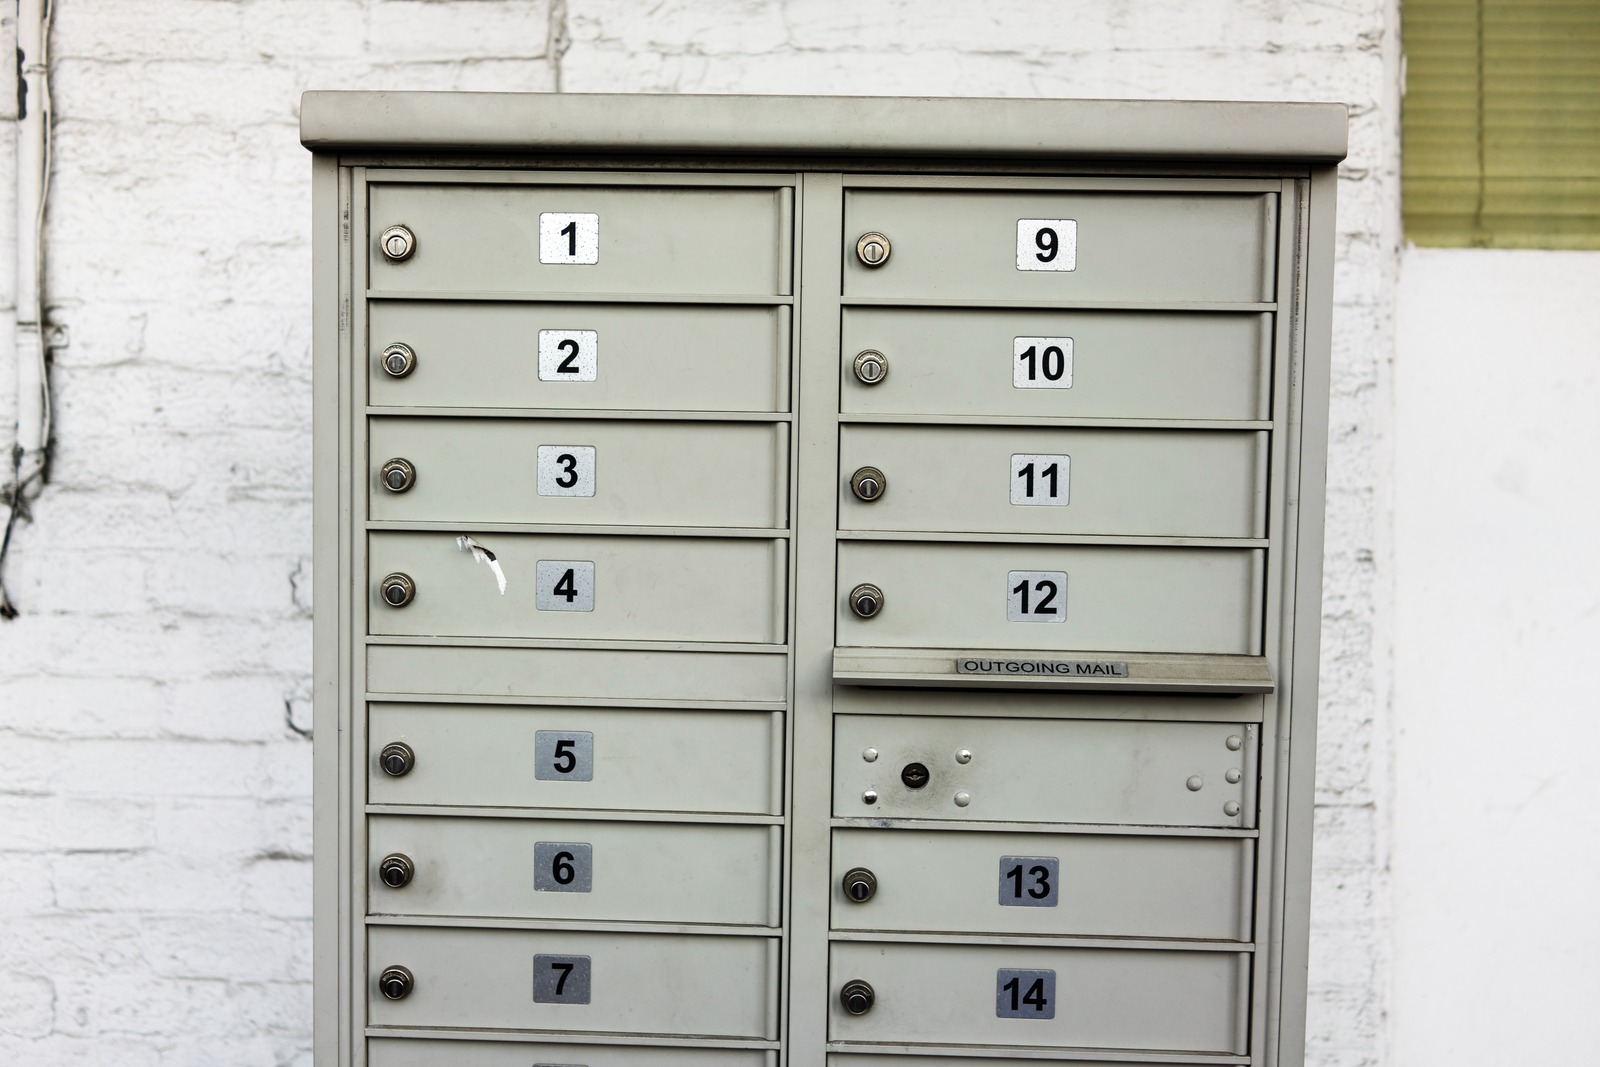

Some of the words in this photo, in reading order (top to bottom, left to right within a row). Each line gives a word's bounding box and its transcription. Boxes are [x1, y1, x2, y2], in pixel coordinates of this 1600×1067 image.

[561, 222, 576, 255] 1
[1036, 228, 1058, 262] 9
[557, 340, 579, 373] 2
[1021, 346, 1064, 380] 10
[556, 454, 578, 488] 3
[1019, 463, 1058, 497] 11
[554, 569, 577, 602] 4
[1014, 580, 1057, 614] 12
[964, 660, 1070, 674] OUTGOING
[1076, 664, 1122, 676] MAIL
[554, 740, 576, 773] 5
[553, 852, 574, 884] 6
[1007, 865, 1050, 899] 13
[552, 963, 573, 995] 7
[1004, 978, 1047, 1011] 14
